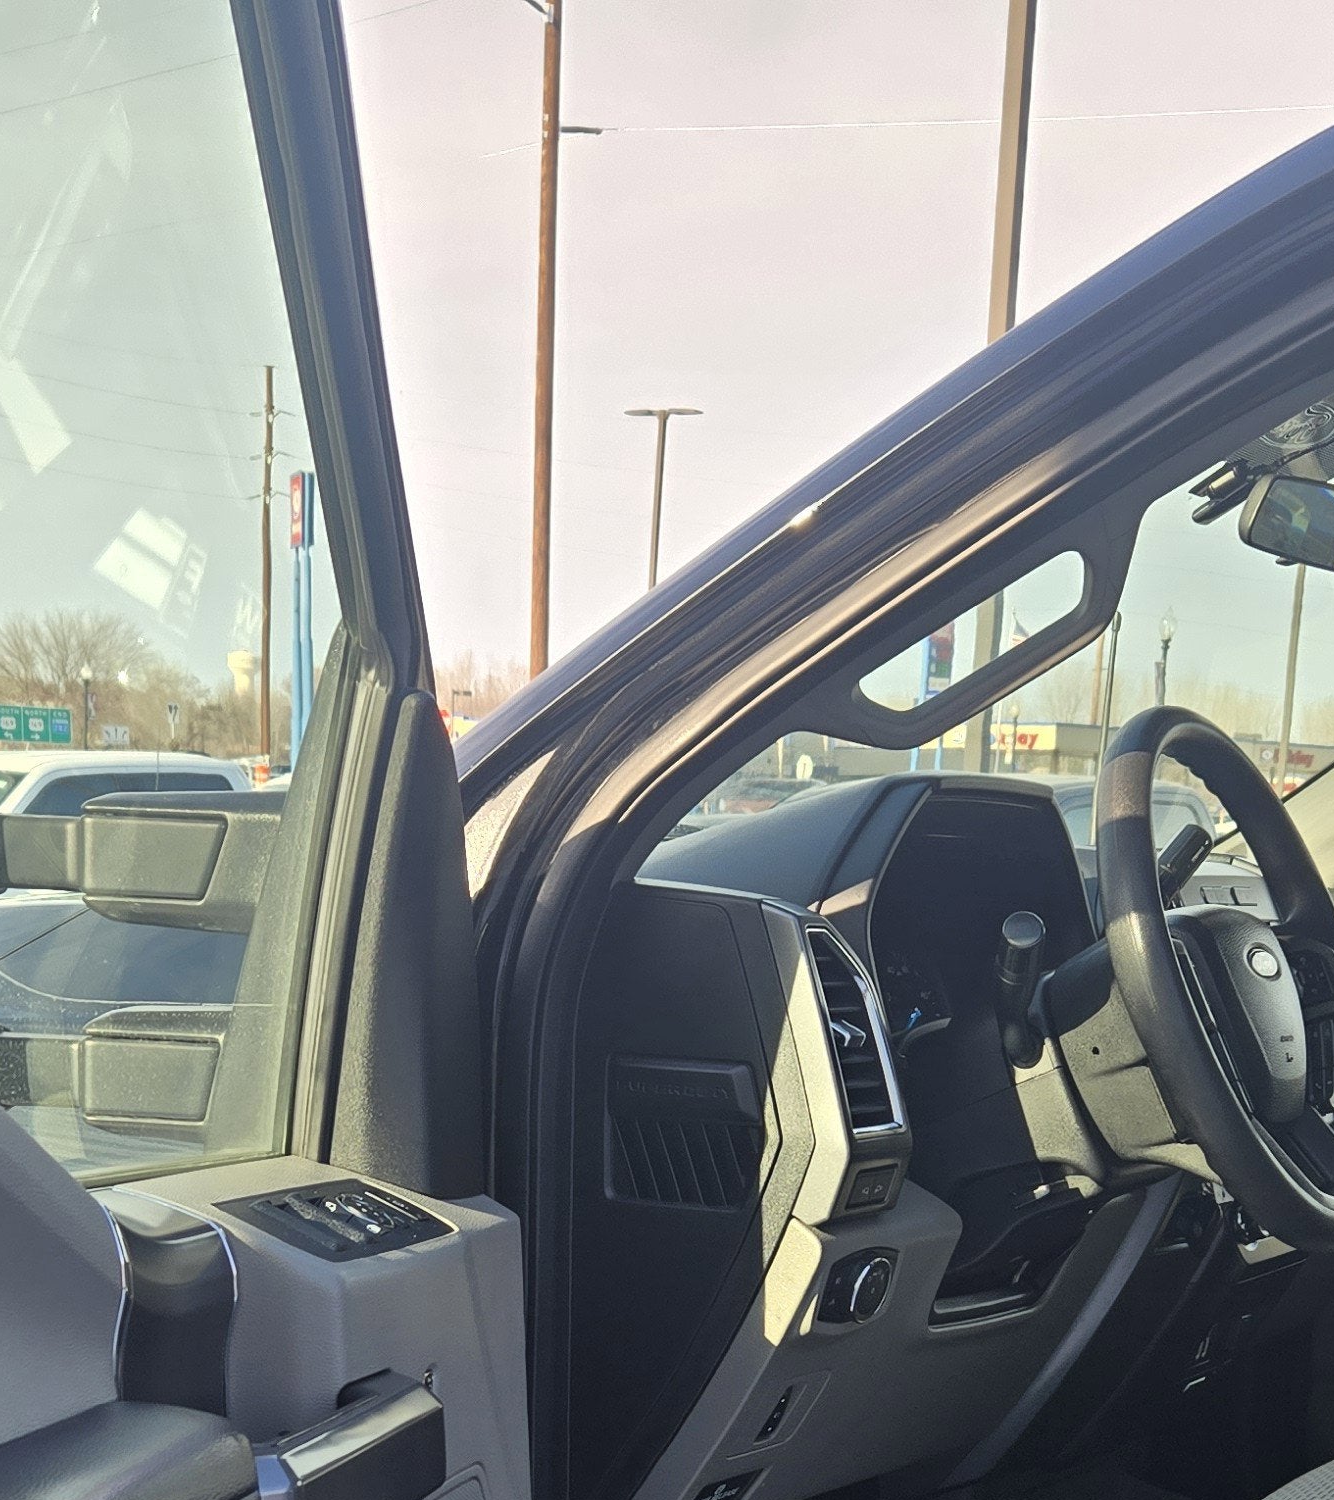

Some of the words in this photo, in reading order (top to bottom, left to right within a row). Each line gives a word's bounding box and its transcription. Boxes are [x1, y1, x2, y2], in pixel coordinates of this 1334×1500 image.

[24, 708, 48, 717] NORTH
[52, 710, 69, 718] END
[2, 718, 15, 727] 169
